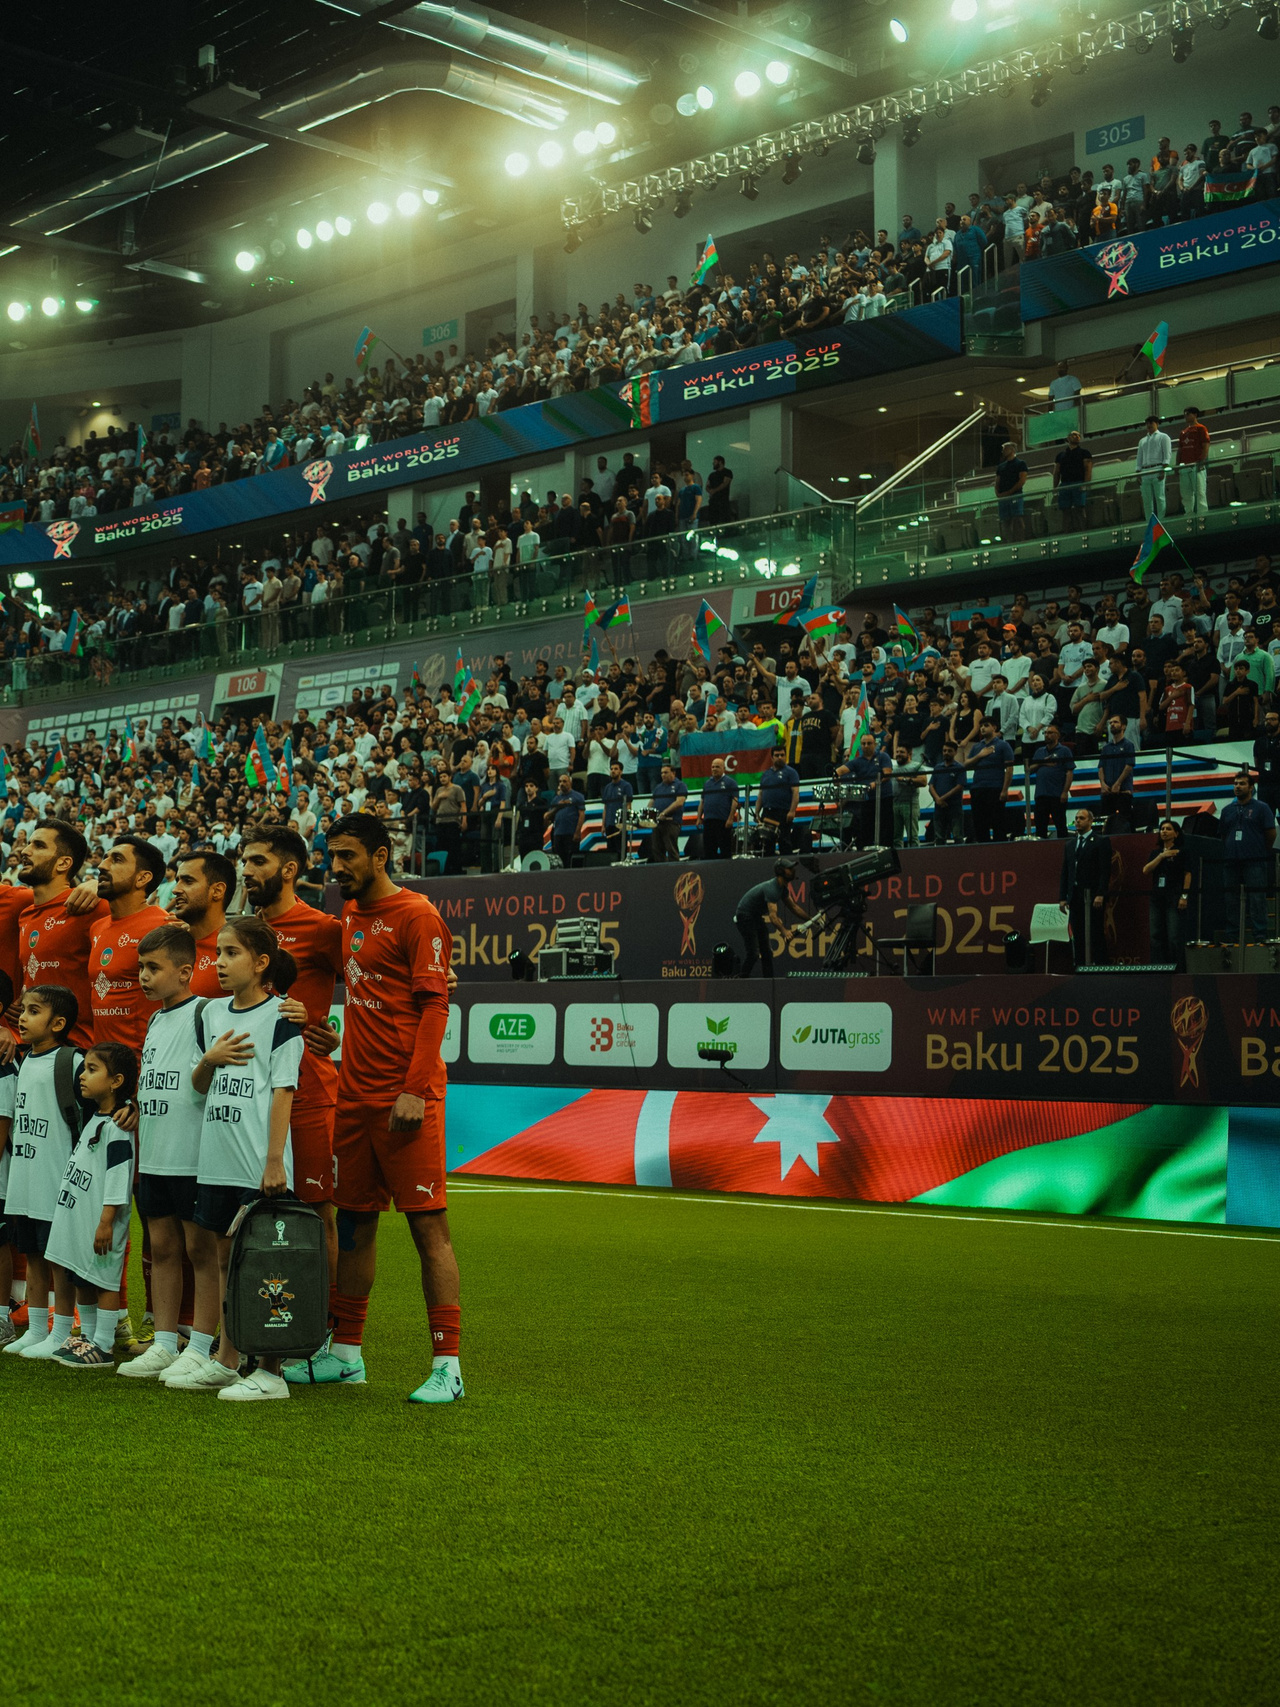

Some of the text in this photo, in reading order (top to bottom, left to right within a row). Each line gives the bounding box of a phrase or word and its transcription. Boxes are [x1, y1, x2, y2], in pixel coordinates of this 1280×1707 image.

[1098, 123, 1131, 147] 305
[1160, 220, 1270, 253] WMF WORLD
[1160, 229, 1280, 268] Baku 20
[430, 324, 450, 342] 306
[683, 352, 841, 400] Baku 2025
[684, 343, 842, 386] WMF WORLD CUP
[347, 437, 461, 470] WMF WORLD CUP
[347, 444, 460, 482] Baku 2025
[94, 507, 184, 533] WMF WORLD CUP
[94, 514, 183, 544] Baku 2025
[236, 675, 257, 693] 106
[868, 870, 1017, 901] ORLD CUP
[484, 894, 567, 916] WORLD
[577, 891, 623, 913] CUP
[452, 921, 621, 967] aku 25
[40, 960, 60, 969] group
[661, 965, 713, 978] Baku 2025
[112, 981, 133, 989] group
[496, 1018, 528, 1036] AZE
[616, 1023, 634, 1031] Baku
[927, 1007, 1142, 1027] WMF WORLD CUP
[616, 1031, 628, 1040] city
[616, 1039, 637, 1048] circuit
[926, 1031, 1140, 1075] Baku 2025
[433, 1331, 444, 1341] 19
